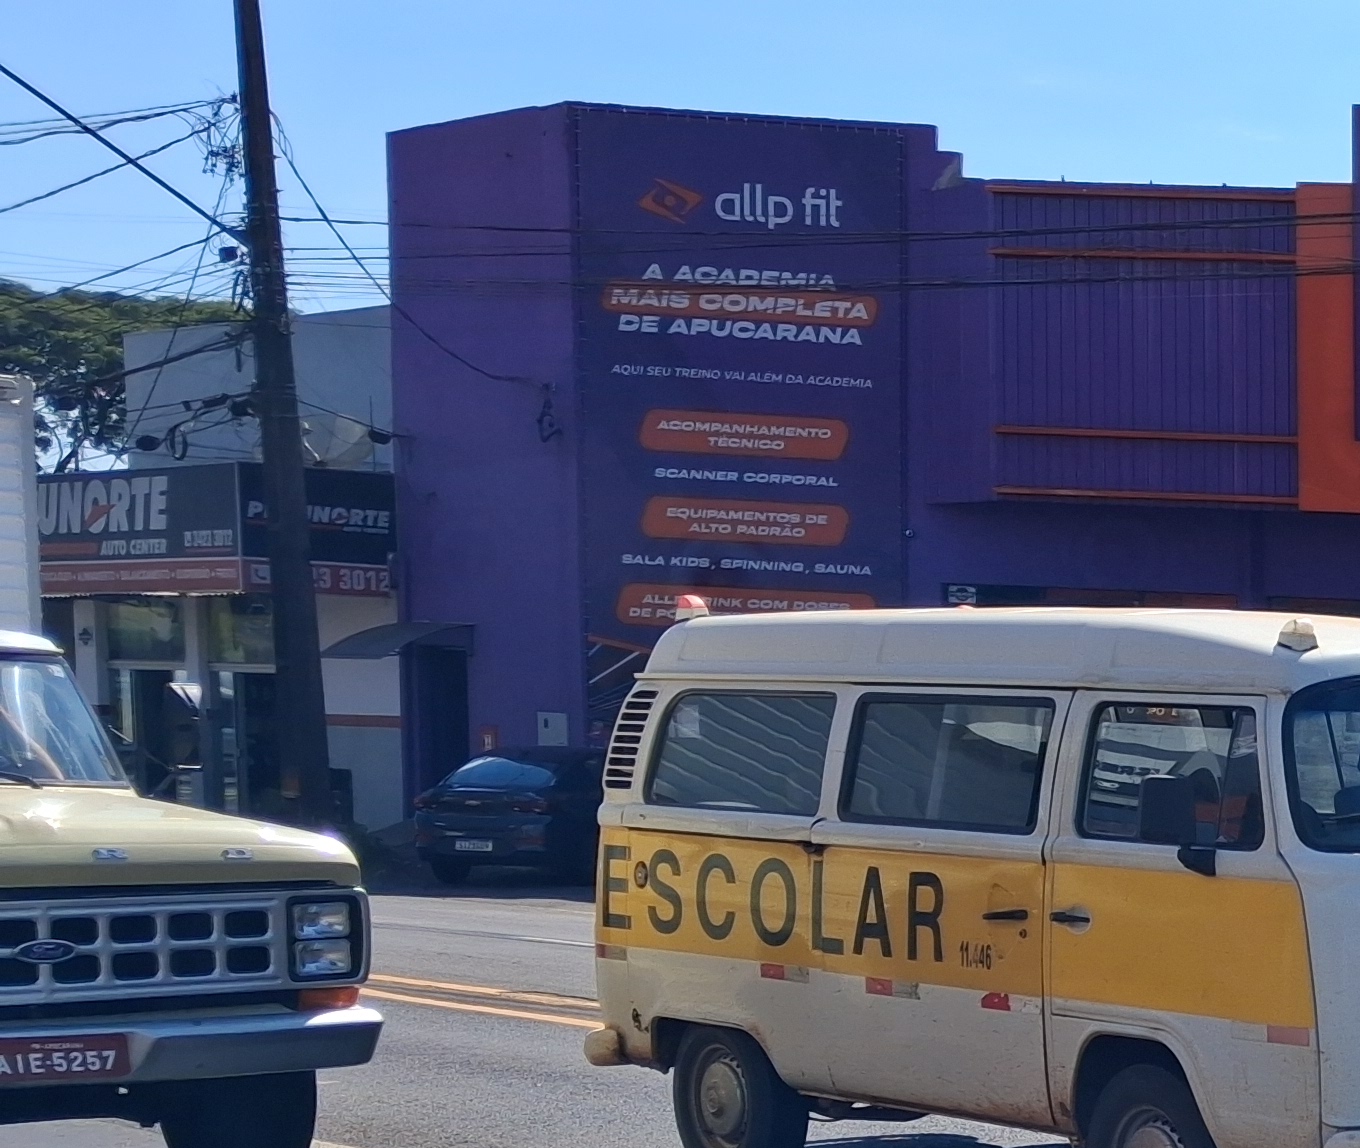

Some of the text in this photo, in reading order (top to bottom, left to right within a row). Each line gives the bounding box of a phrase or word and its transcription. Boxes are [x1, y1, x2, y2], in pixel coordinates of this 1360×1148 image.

[715, 183, 843, 230] allp fit
[642, 263, 836, 291] A ACADEMIA
[611, 288, 868, 319] MAIS COMPLETA
[618, 315, 863, 345] DE APUCARANA
[611, 364, 643, 376] AQUI
[646, 365, 671, 377] SEU
[674, 367, 721, 380] TREINO
[724, 371, 745, 381] VAI
[785, 374, 803, 385] DA
[807, 376, 873, 389] ACADEMIA
[657, 420, 832, 439] ACOMPANHAMENTO
[707, 435, 785, 450] TÉCNICO
[654, 467, 839, 487] SCANNER CORPORAL
[666, 507, 828, 525] EQUIPAMENTOS DE
[688, 523, 806, 537] ALTO PADRÃO
[100, 538, 167, 556] AUTO CENTER
[621, 553, 872, 576] SALA KIDS, SPINNING, SAUNA
[339, 568, 390, 592] 3012
[642, 593, 679, 605] ALL
[747, 599, 788, 610] COM
[629, 607, 652, 618] DE
[603, 844, 944, 963] ESCOLAR
